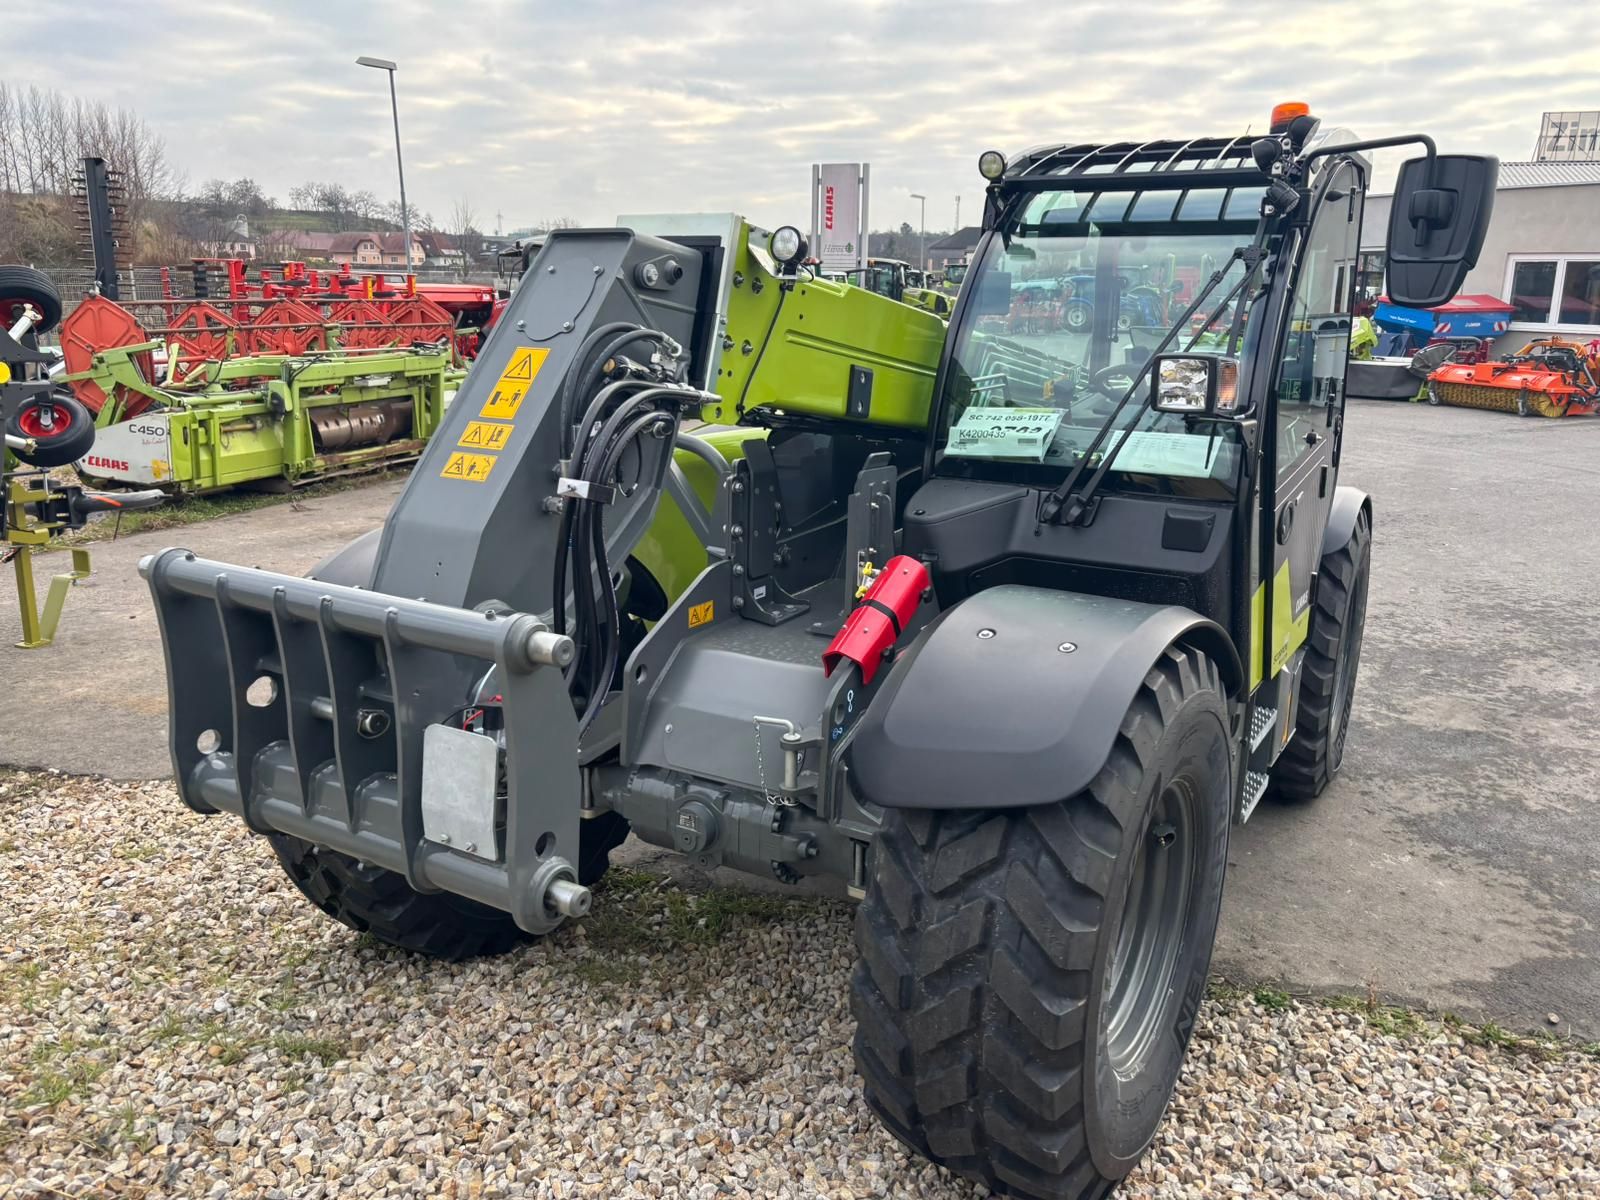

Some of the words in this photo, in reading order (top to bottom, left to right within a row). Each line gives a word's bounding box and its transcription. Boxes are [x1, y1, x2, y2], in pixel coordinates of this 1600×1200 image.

[825, 186, 834, 230] CLAAS
[960, 429, 1006, 438] K4200435
[87, 456, 129, 471] CLAAS
